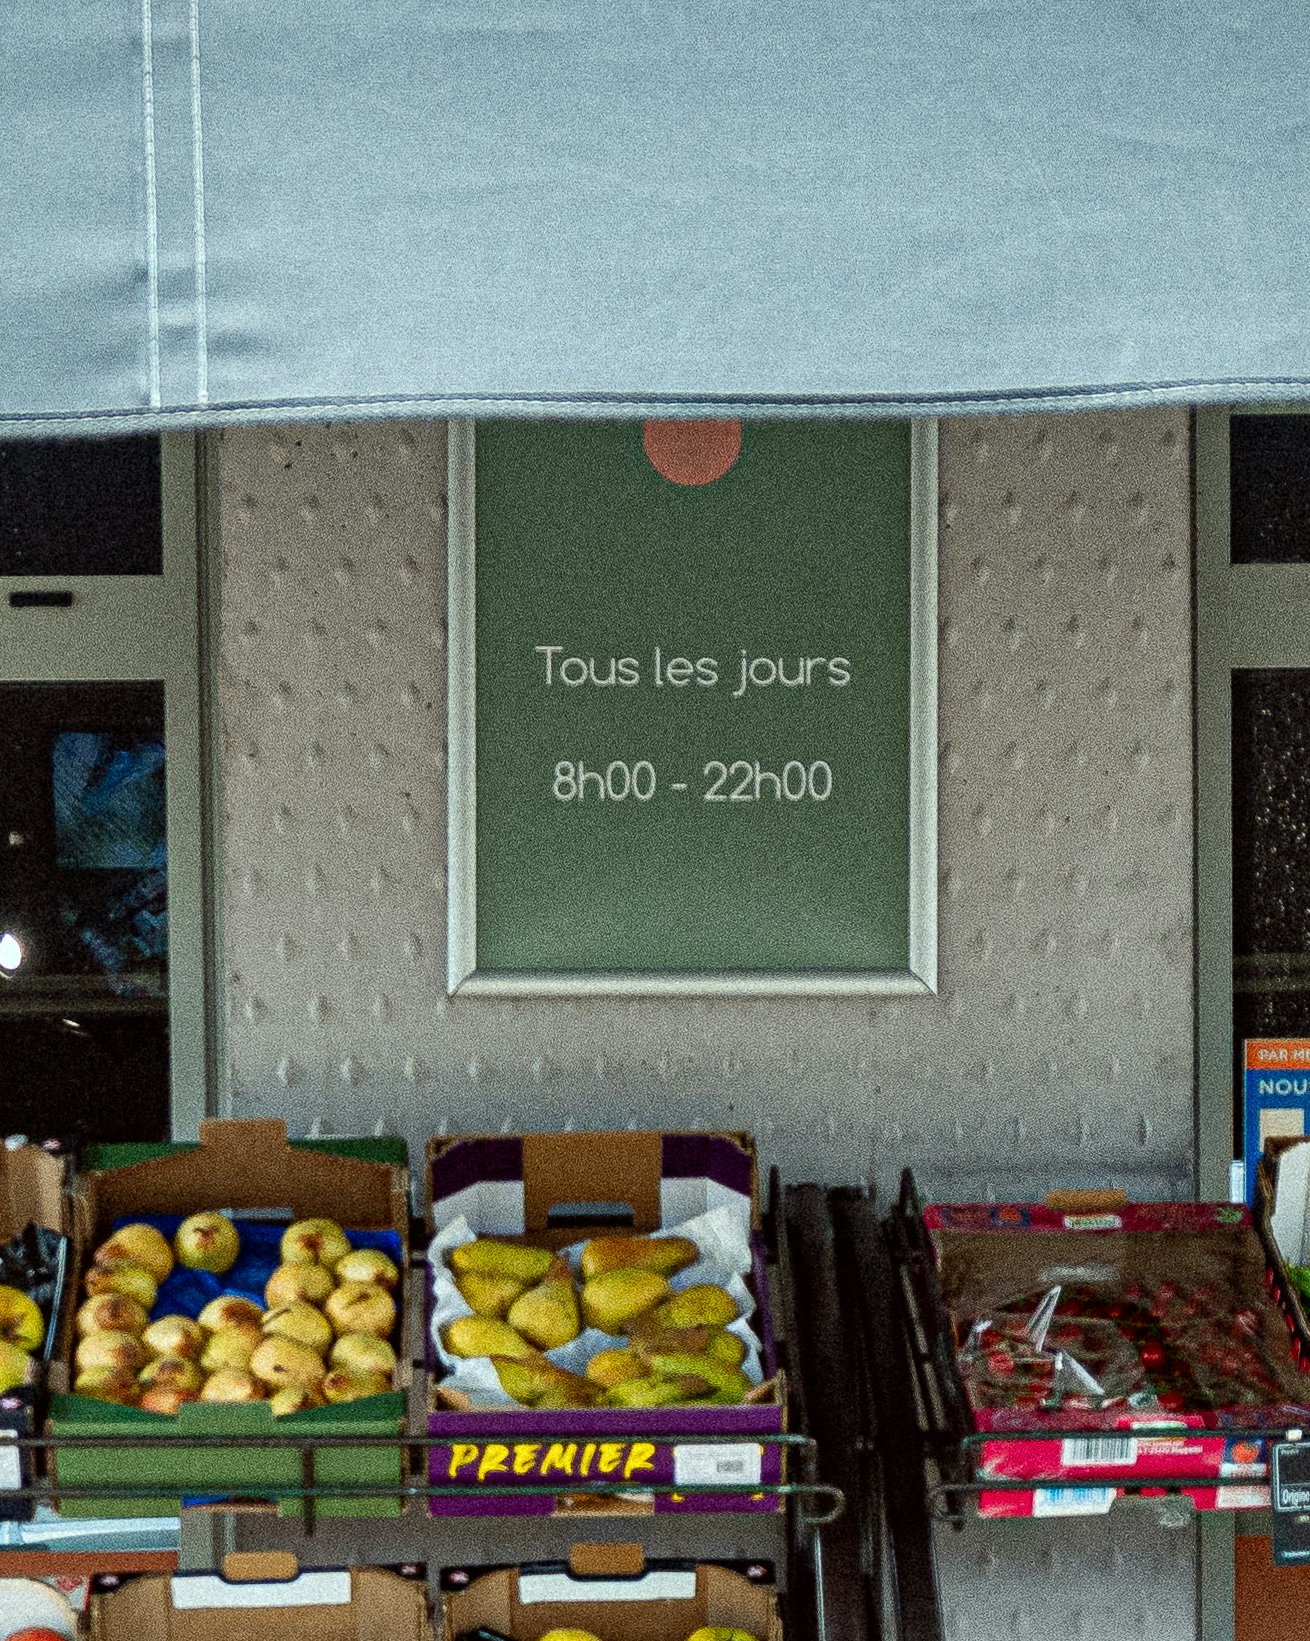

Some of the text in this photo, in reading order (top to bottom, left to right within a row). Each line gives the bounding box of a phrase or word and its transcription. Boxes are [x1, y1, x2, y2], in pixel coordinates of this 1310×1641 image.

[535, 646, 851, 697] Tous les jours
[553, 760, 657, 800] 8h00
[702, 760, 833, 800] 22h00
[1258, 1048, 1288, 1061] PAR
[448, 1442, 656, 1482] PREMIER
